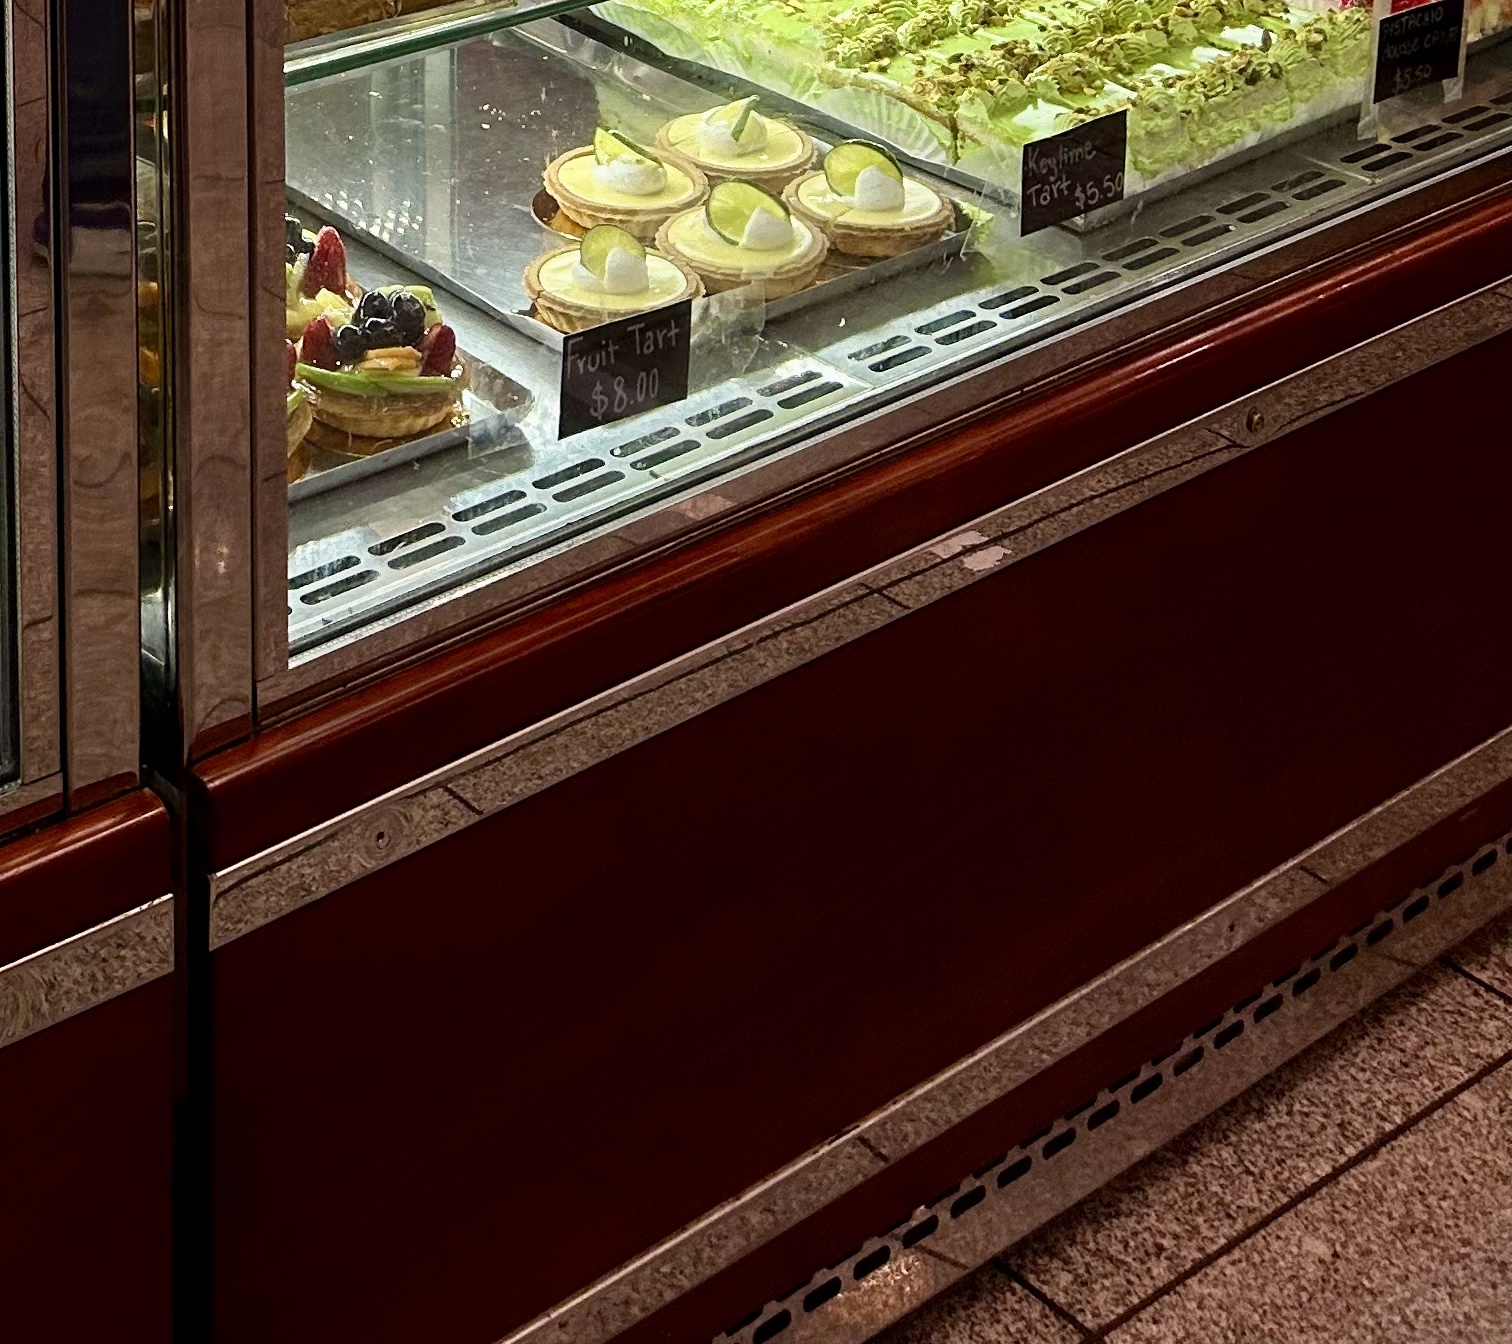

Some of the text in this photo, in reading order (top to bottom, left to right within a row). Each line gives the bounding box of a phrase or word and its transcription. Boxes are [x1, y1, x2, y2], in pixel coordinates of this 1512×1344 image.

[1027, 172, 1124, 210] Tart $5.50
[567, 319, 681, 379] Fruit Tart
[589, 367, 659, 421] $8.00
